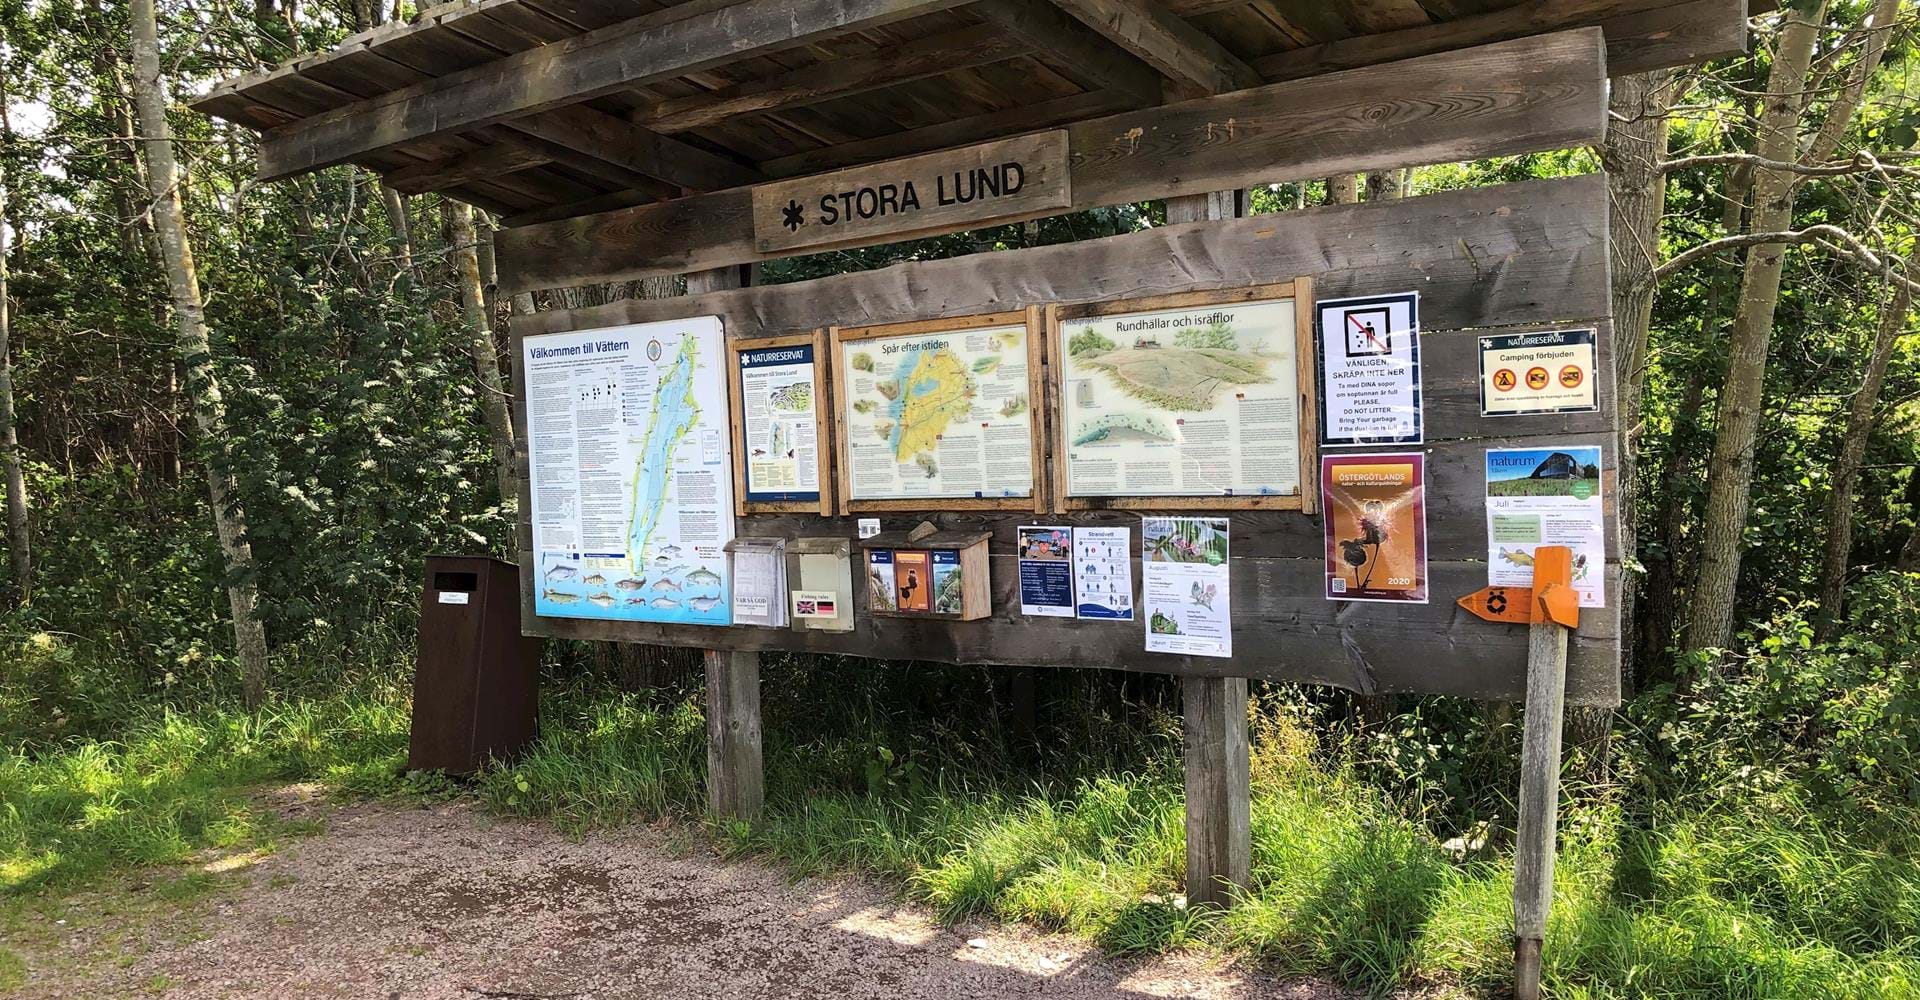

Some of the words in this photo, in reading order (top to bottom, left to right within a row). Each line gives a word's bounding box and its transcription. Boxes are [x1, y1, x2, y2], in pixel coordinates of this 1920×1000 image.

[820, 181, 920, 226] STORA
[937, 161, 1025, 207] LUND
[1116, 315, 1170, 332] Rundhällar
[1173, 315, 1192, 328] och
[1194, 312, 1235, 325] isräfflor
[1507, 335, 1565, 346] NATURRESERVAT
[530, 346, 581, 359] Välkommen
[582, 342, 594, 354] till
[595, 340, 630, 353] Vättern
[882, 343, 900, 355] Spår
[901, 341, 920, 352] efter
[921, 339, 949, 351] istiden
[751, 350, 804, 363] NATURRESERVAT
[1499, 352, 1534, 362] Camping
[1536, 350, 1575, 360] förbjuden
[1332, 370, 1365, 379] SKRÄPA
[1387, 368, 1405, 376] NER
[1491, 456, 1535, 467] naturum
[1338, 472, 1406, 481] ÖSTERGÖTLANDS
[1494, 500, 1510, 508] Juli
[1387, 577, 1411, 586] 2020
